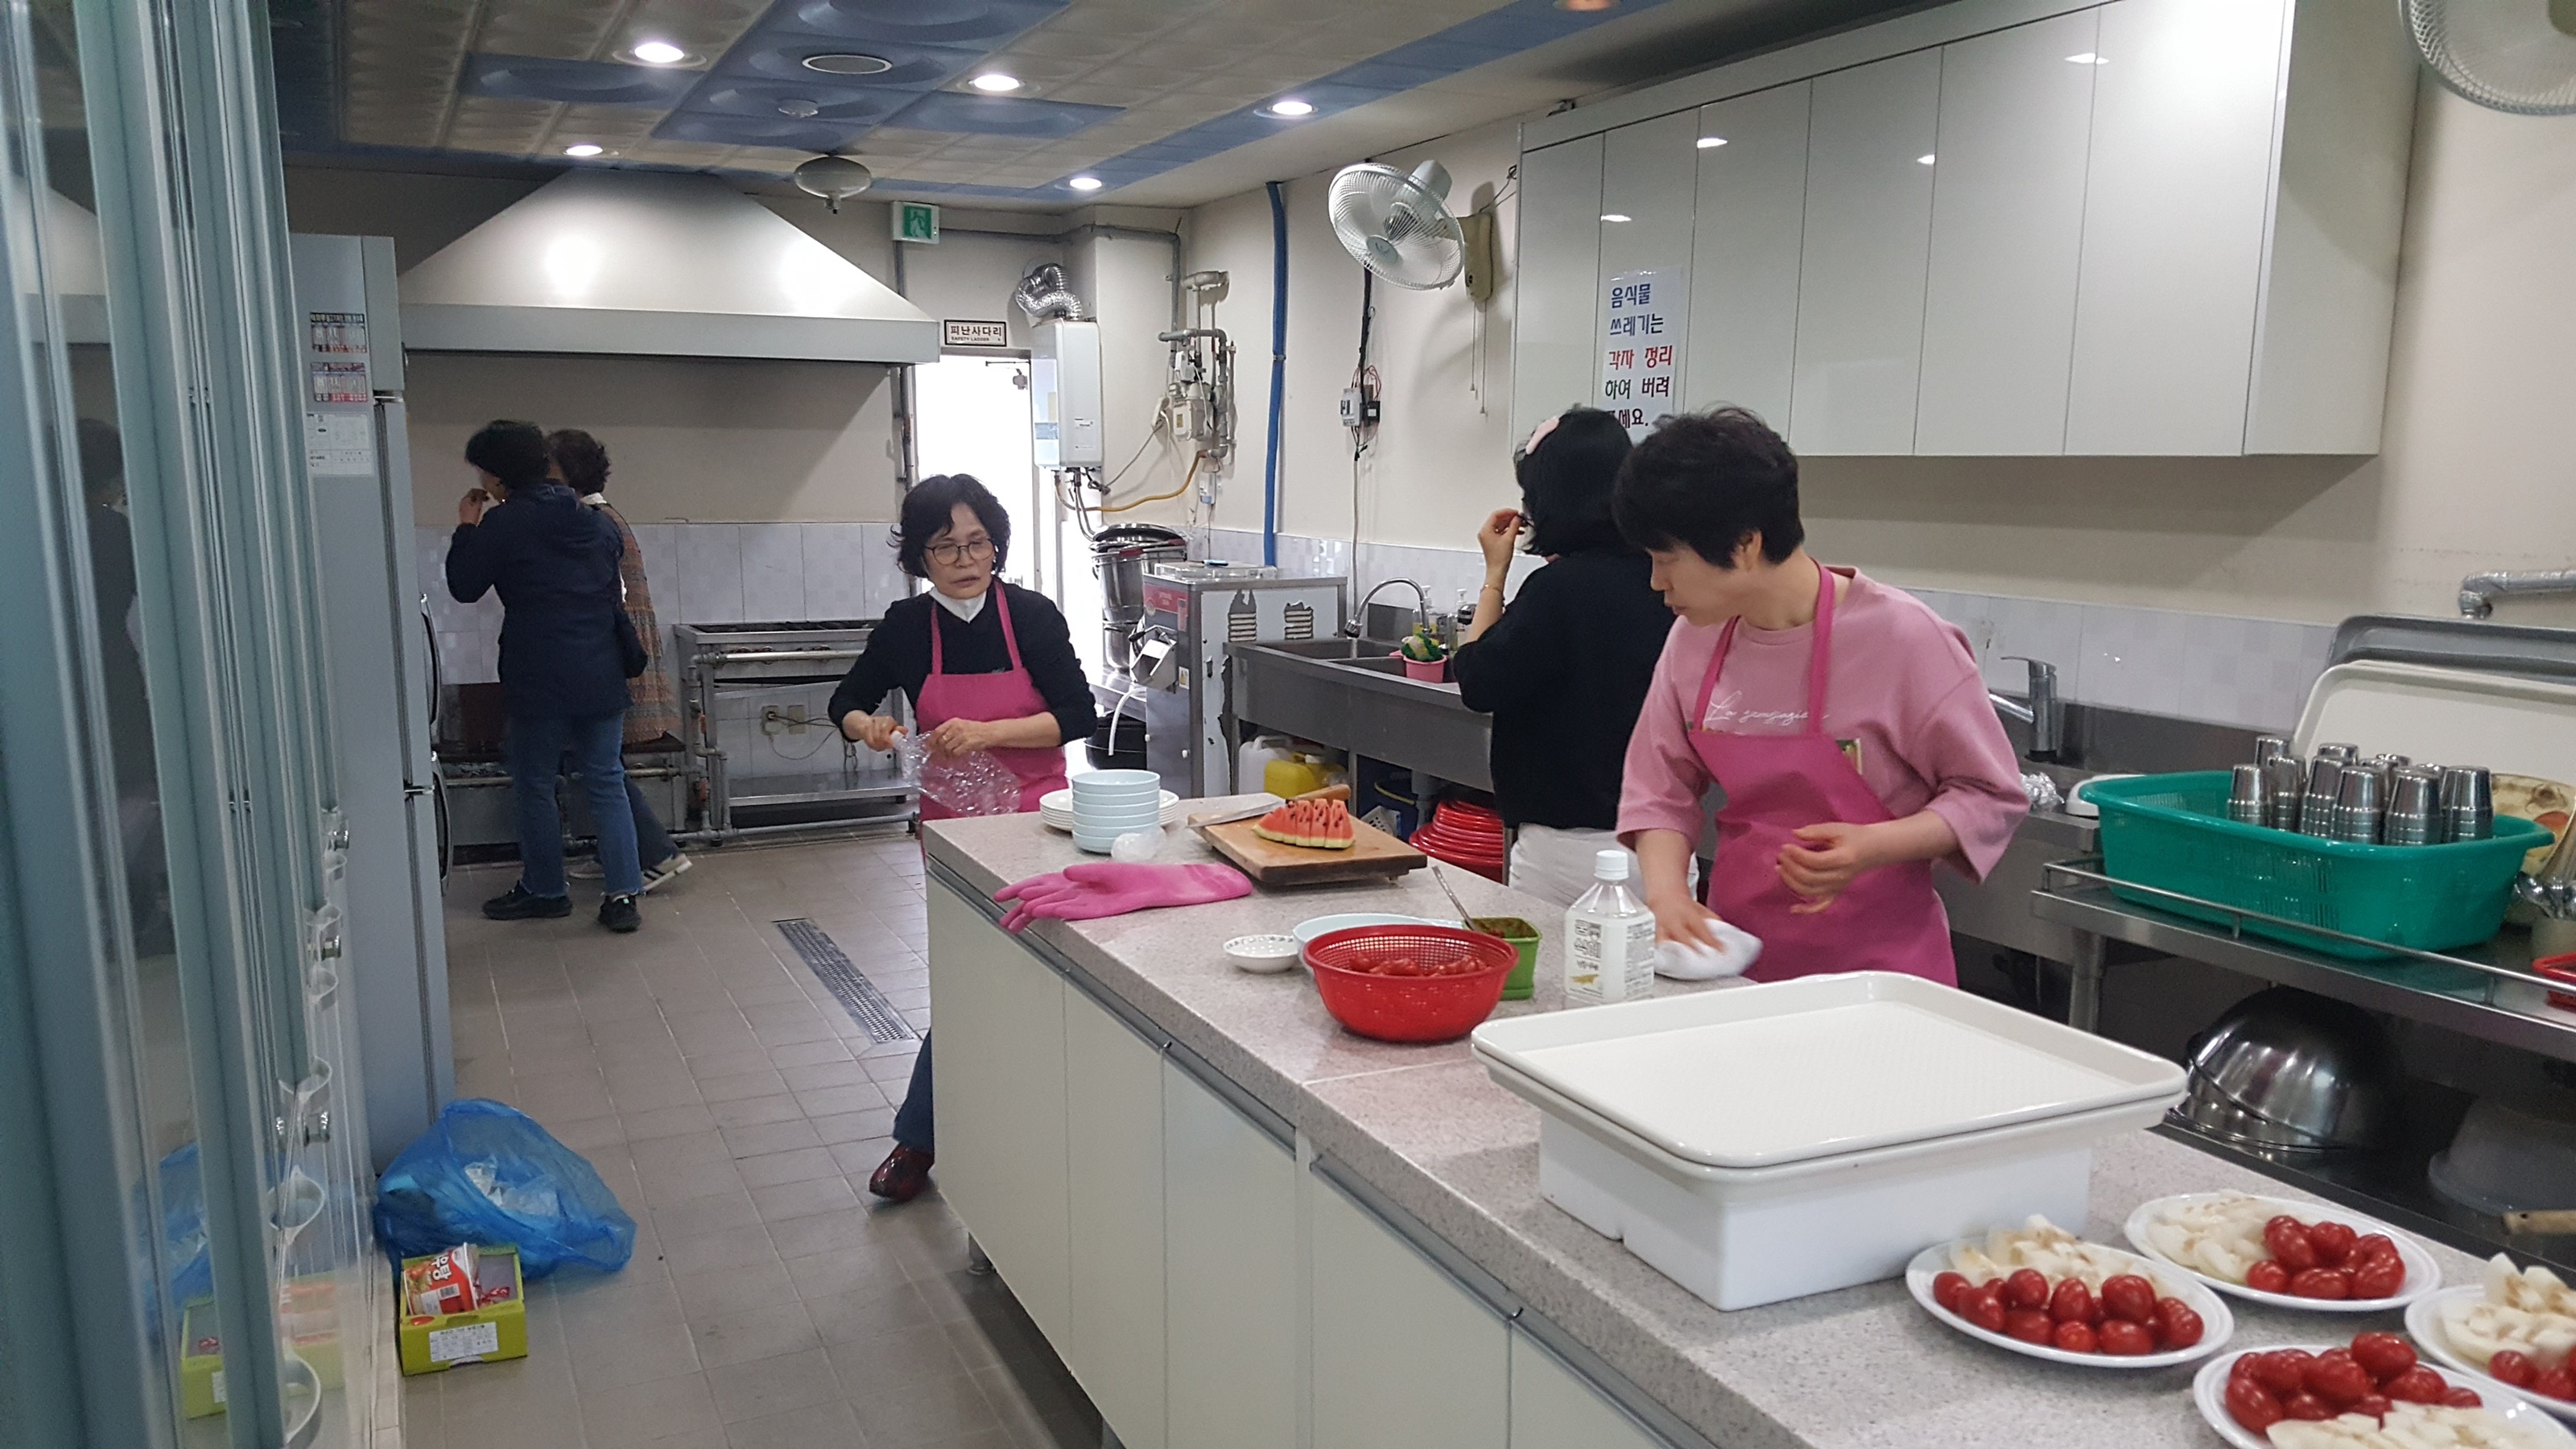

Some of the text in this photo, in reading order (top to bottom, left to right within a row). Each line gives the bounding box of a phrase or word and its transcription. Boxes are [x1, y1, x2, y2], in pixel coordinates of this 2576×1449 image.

[1611, 283, 1651, 308] 음식물
[951, 325, 1002, 336] 피난사다리
[1609, 313, 1664, 336] 쓰레기는
[1608, 345, 1673, 370] 각자 정리
[1605, 376, 1670, 400] 하여 버려
